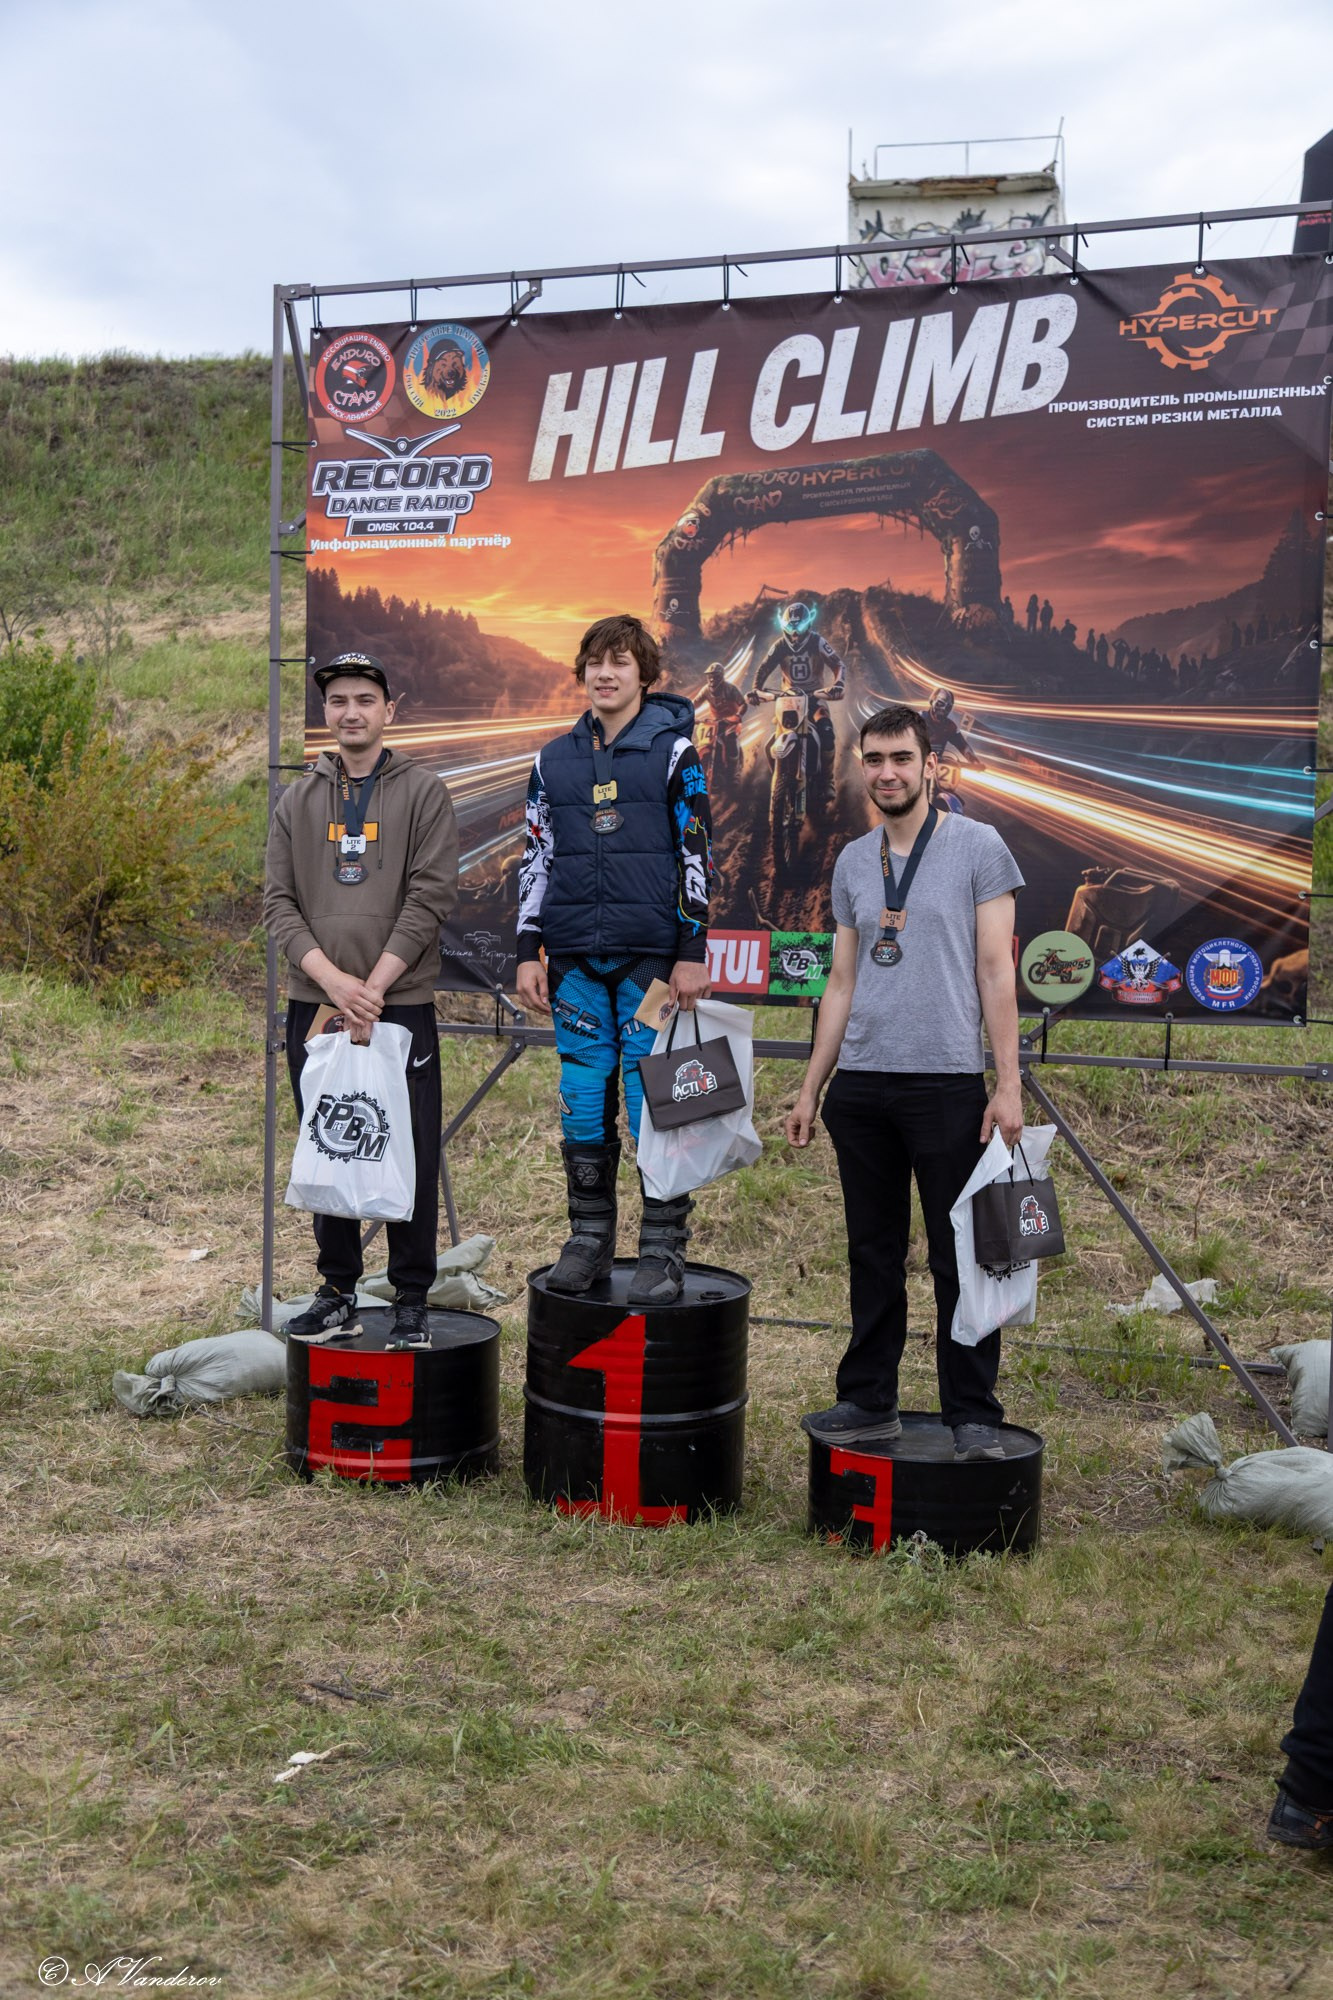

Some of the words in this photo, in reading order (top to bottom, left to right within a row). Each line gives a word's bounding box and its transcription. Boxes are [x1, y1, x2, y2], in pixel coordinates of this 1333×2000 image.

[1119, 308, 1279, 336] HYPERCUT
[331, 348, 381, 371] ENDURO
[528, 348, 726, 482] HILL
[750, 293, 1078, 452] CLIMB
[1048, 394, 1180, 414] ПРОИЗВОДИТЕЛЬ
[1183, 385, 1327, 404] ПРОМЫШЛЕННЫХ
[434, 408, 457, 417] 2022
[1086, 413, 1148, 429] СИСТЕМ
[1151, 410, 1204, 425] РЕЗКИ
[1207, 405, 1282, 422] МЕТАЛЛА
[314, 459, 492, 492] RECORD
[330, 496, 403, 514] DANCE
[404, 494, 470, 512] RADIO
[367, 522, 400, 532] OMSK
[402, 521, 434, 531] 104.4
[310, 537, 446, 552] Информационный
[450, 534, 512, 549] партнёр
[597, 786, 612, 794] LITE
[705, 939, 764, 984] TUL
[1210, 968, 1239, 987] МФР
[1211, 1000, 1236, 1009] MFR
[673, 1073, 716, 1099] ACTIVE
[1020, 1212, 1048, 1234] ACTIVE
[307, 1344, 415, 1482] 2
[556, 1315, 688, 1526] 1
